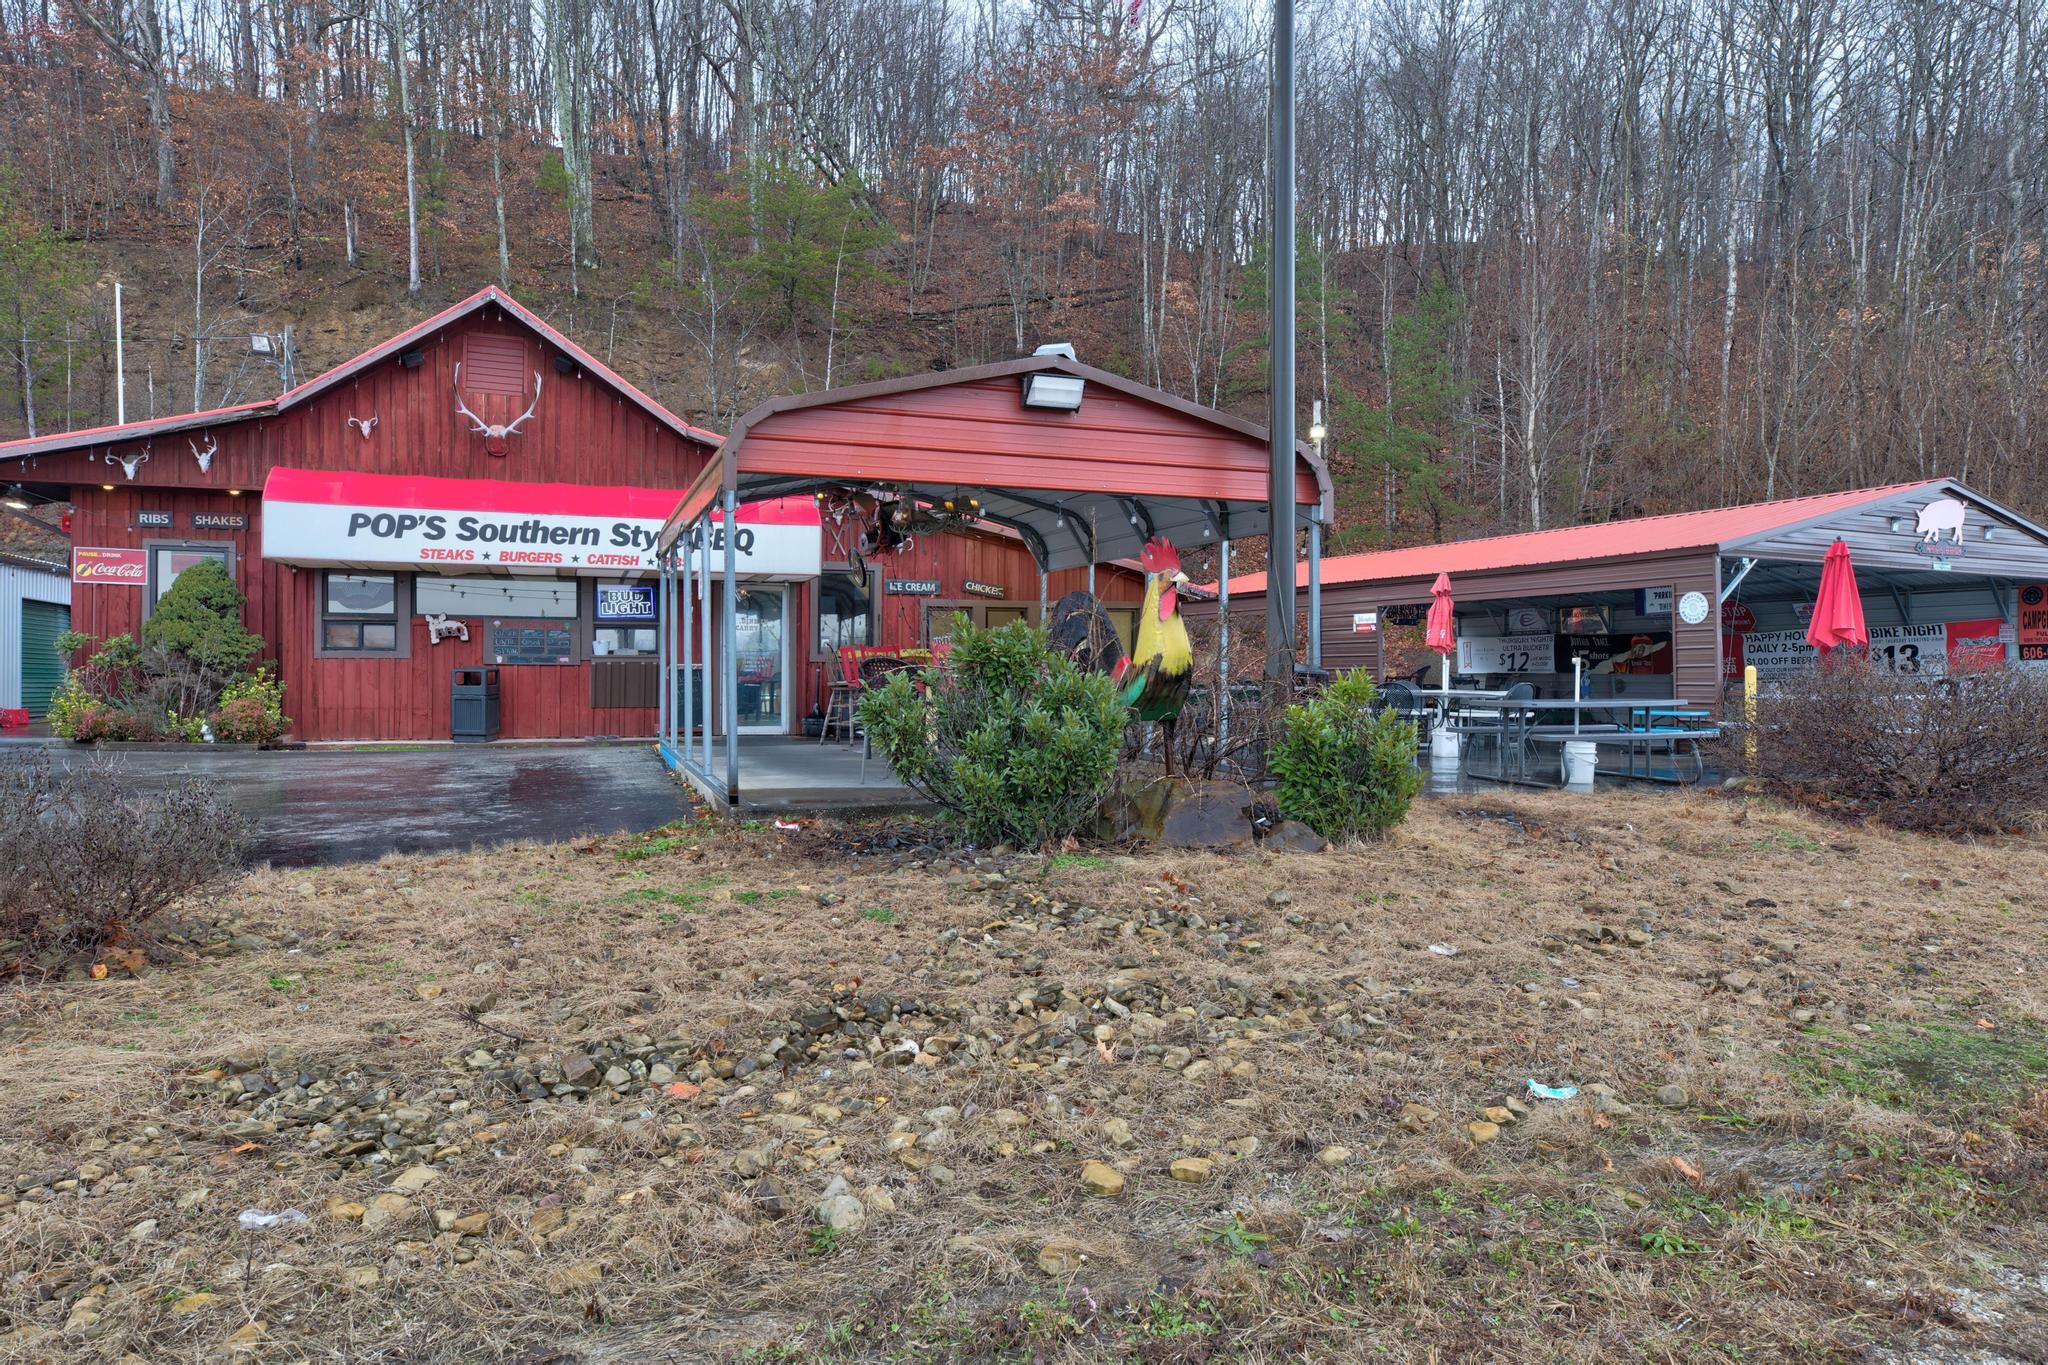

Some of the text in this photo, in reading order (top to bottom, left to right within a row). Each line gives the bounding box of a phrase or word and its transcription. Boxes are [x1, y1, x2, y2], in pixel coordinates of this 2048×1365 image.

[138, 513, 169, 525] RIBS
[194, 515, 244, 527] SHAKES
[347, 513, 448, 541] POP'S
[456, 516, 600, 546] Southern
[609, 522, 684, 552] Sty
[419, 547, 640, 567] STEAKS BURGERS CATFISH
[92, 562, 145, 577] Coca-Cola
[905, 583, 936, 592] CREAM
[607, 589, 645, 603] BUD
[600, 601, 652, 615] LIGHT
[2023, 610, 2048, 630] CAMPG
[1745, 630, 1808, 642] HAPPY HOU
[1870, 624, 1943, 638] BIKE NIGHT
[1748, 644, 1779, 653] DAILY
[1499, 651, 1530, 672] $12
[1589, 652, 1610, 660] shots
[1771, 657, 1789, 665] OFF
